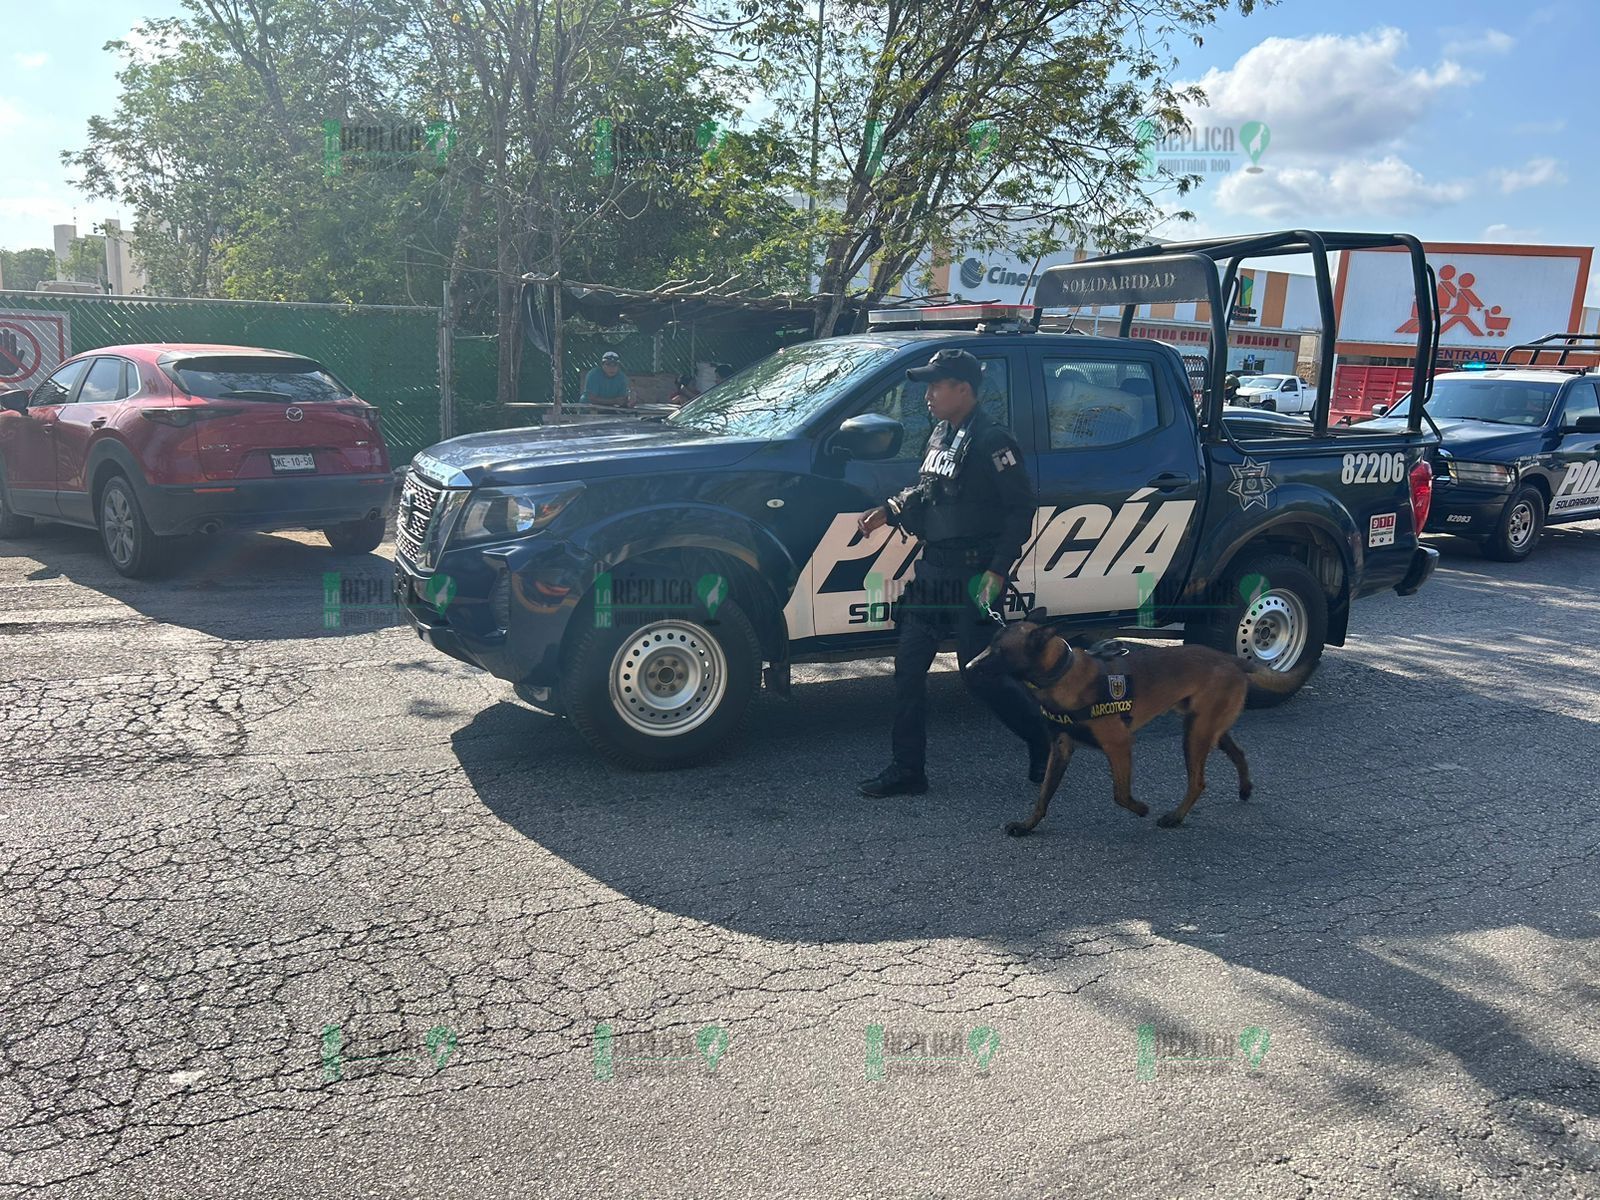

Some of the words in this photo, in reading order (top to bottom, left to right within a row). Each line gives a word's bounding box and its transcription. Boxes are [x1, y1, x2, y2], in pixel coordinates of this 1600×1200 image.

[1062, 272, 1177, 293] SOLIDARIDAD
[1181, 330, 1209, 343] CHIN
[1437, 350, 1498, 362] ENTRADA
[1341, 452, 1405, 485] 82206
[797, 487, 1197, 594] POICÍA
